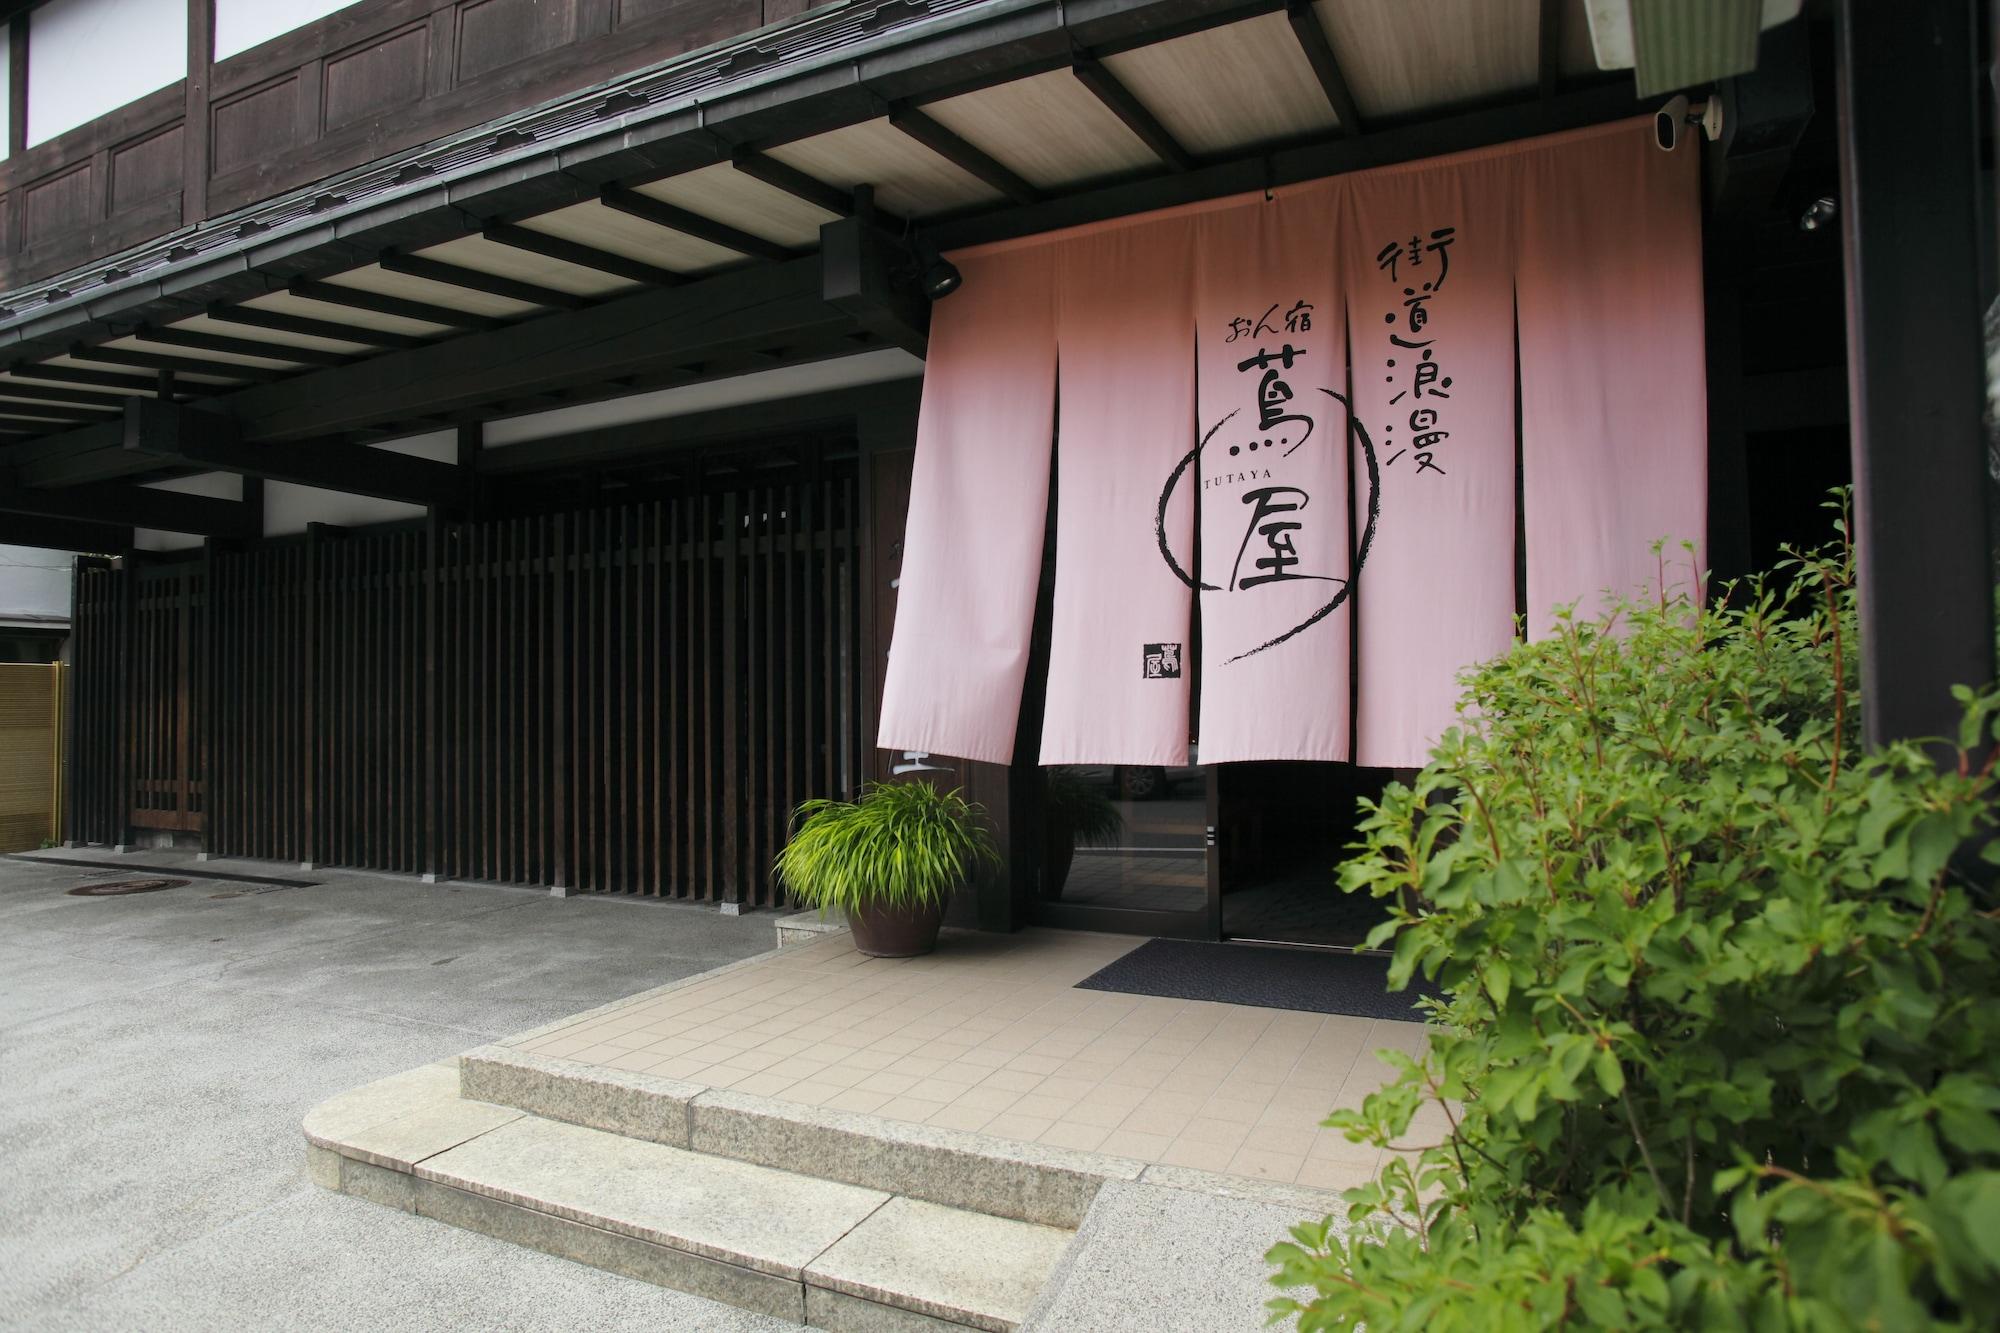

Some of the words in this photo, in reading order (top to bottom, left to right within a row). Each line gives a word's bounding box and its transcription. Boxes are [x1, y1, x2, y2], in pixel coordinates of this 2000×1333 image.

[1225, 300, 1314, 343] おん宿
[1376, 227, 1456, 475] 街道浪漫
[1203, 468, 1272, 490] TUTAYA
[1229, 344, 1342, 592] 蔦屋
